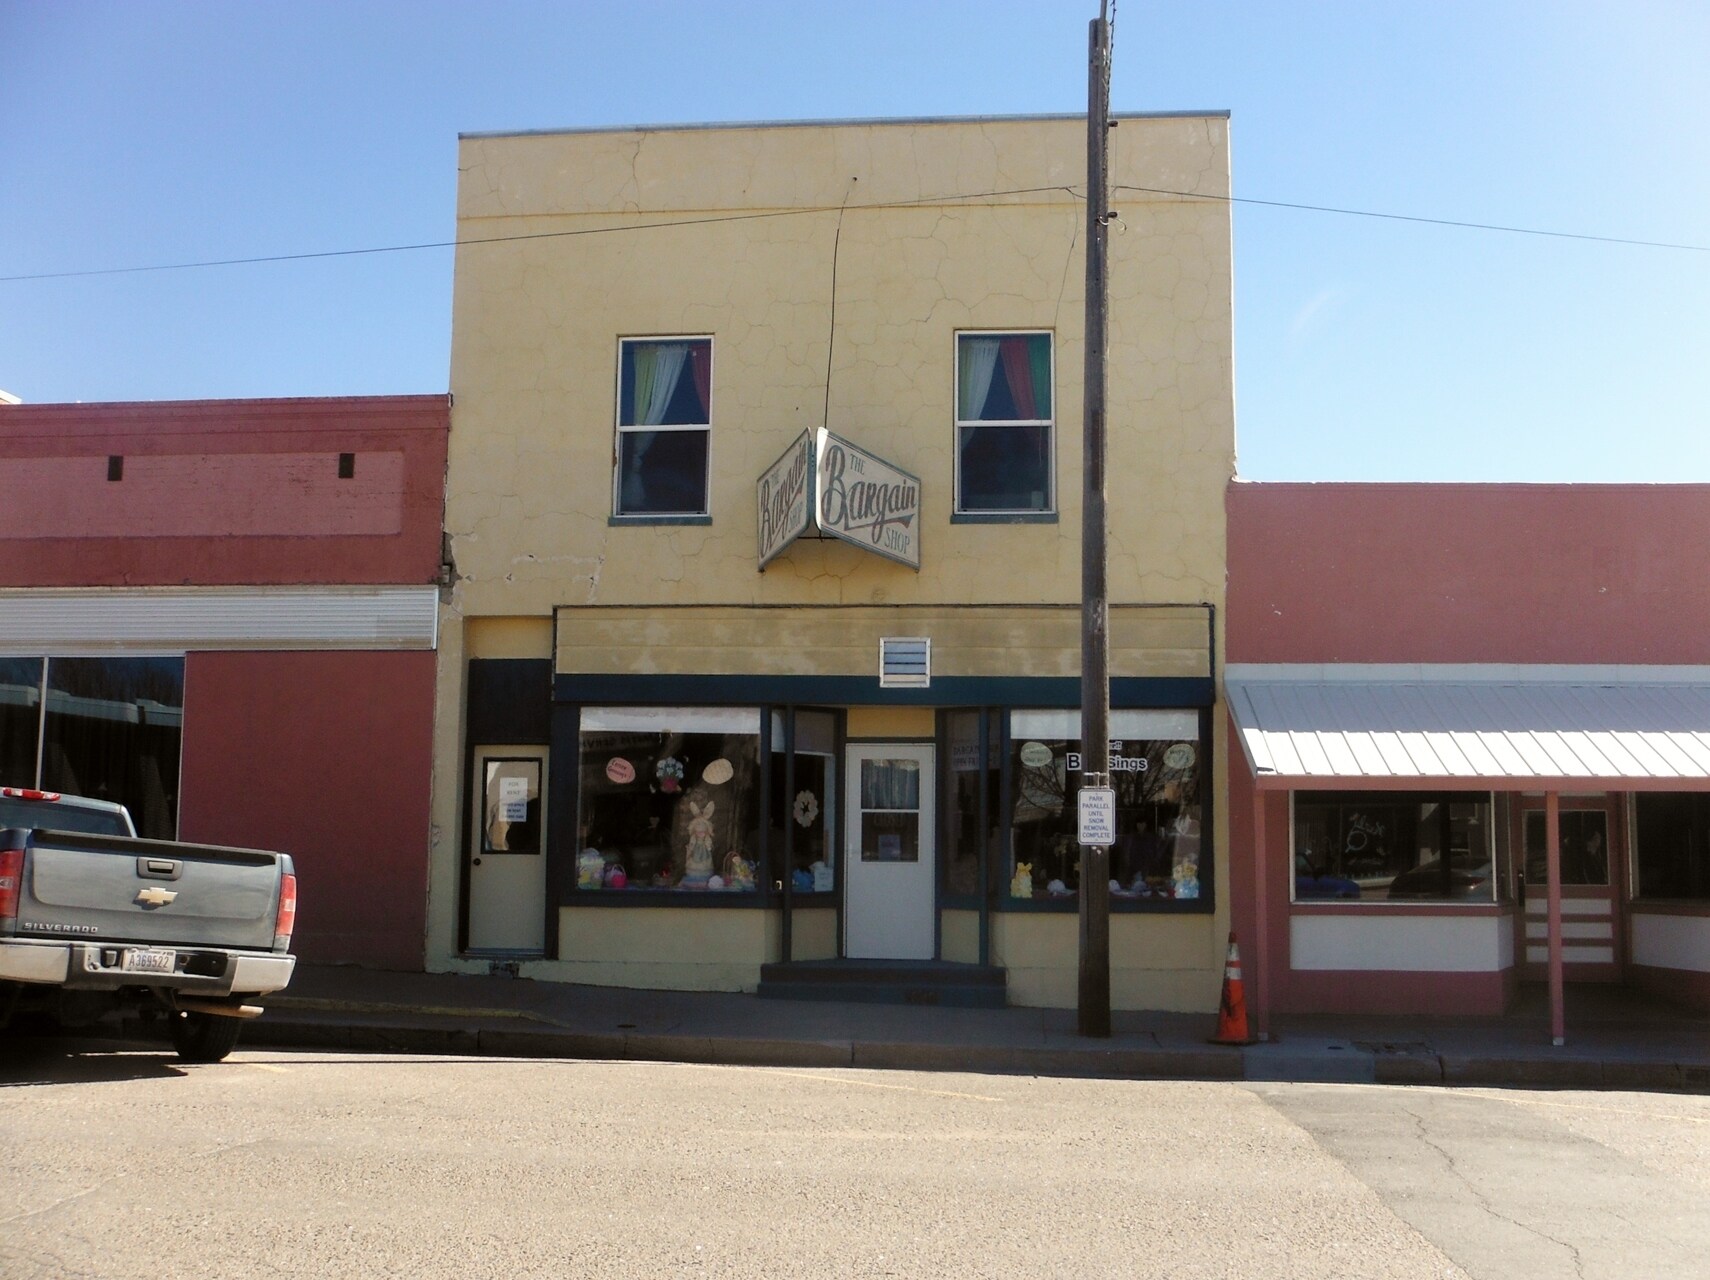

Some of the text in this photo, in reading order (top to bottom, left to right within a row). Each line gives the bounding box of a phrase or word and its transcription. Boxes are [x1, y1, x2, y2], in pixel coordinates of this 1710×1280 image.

[850, 454, 865, 476] THE
[821, 444, 917, 544] Bargain
[884, 527, 910, 555] SHOP
[24, 922, 99, 933] SILVERADO
